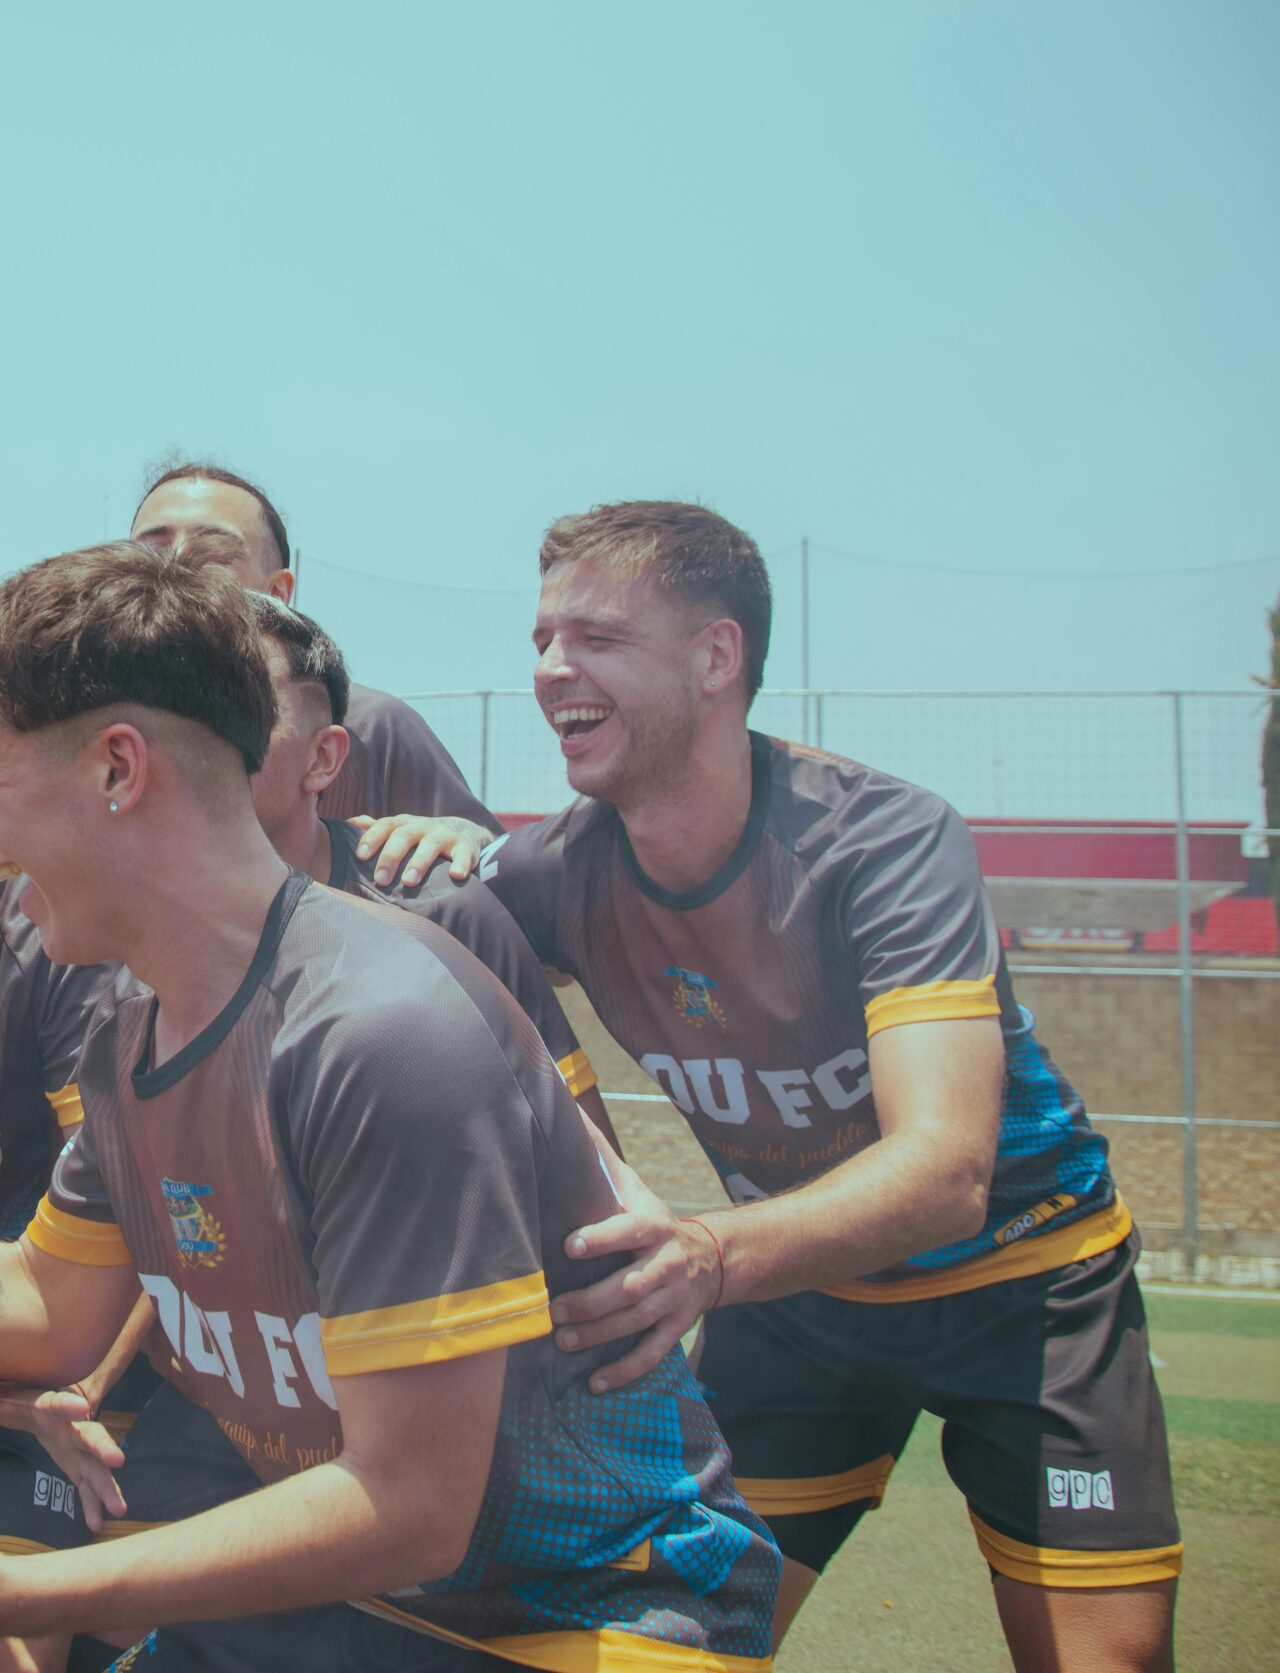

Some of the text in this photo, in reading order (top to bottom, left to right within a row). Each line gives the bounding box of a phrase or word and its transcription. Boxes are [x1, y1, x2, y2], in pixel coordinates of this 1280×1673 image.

[639, 1048, 873, 1129] OU FC
[797, 1122, 868, 1168] pueblo
[264, 1431, 290, 1464] del
[1048, 1471, 1112, 1507] gpc
